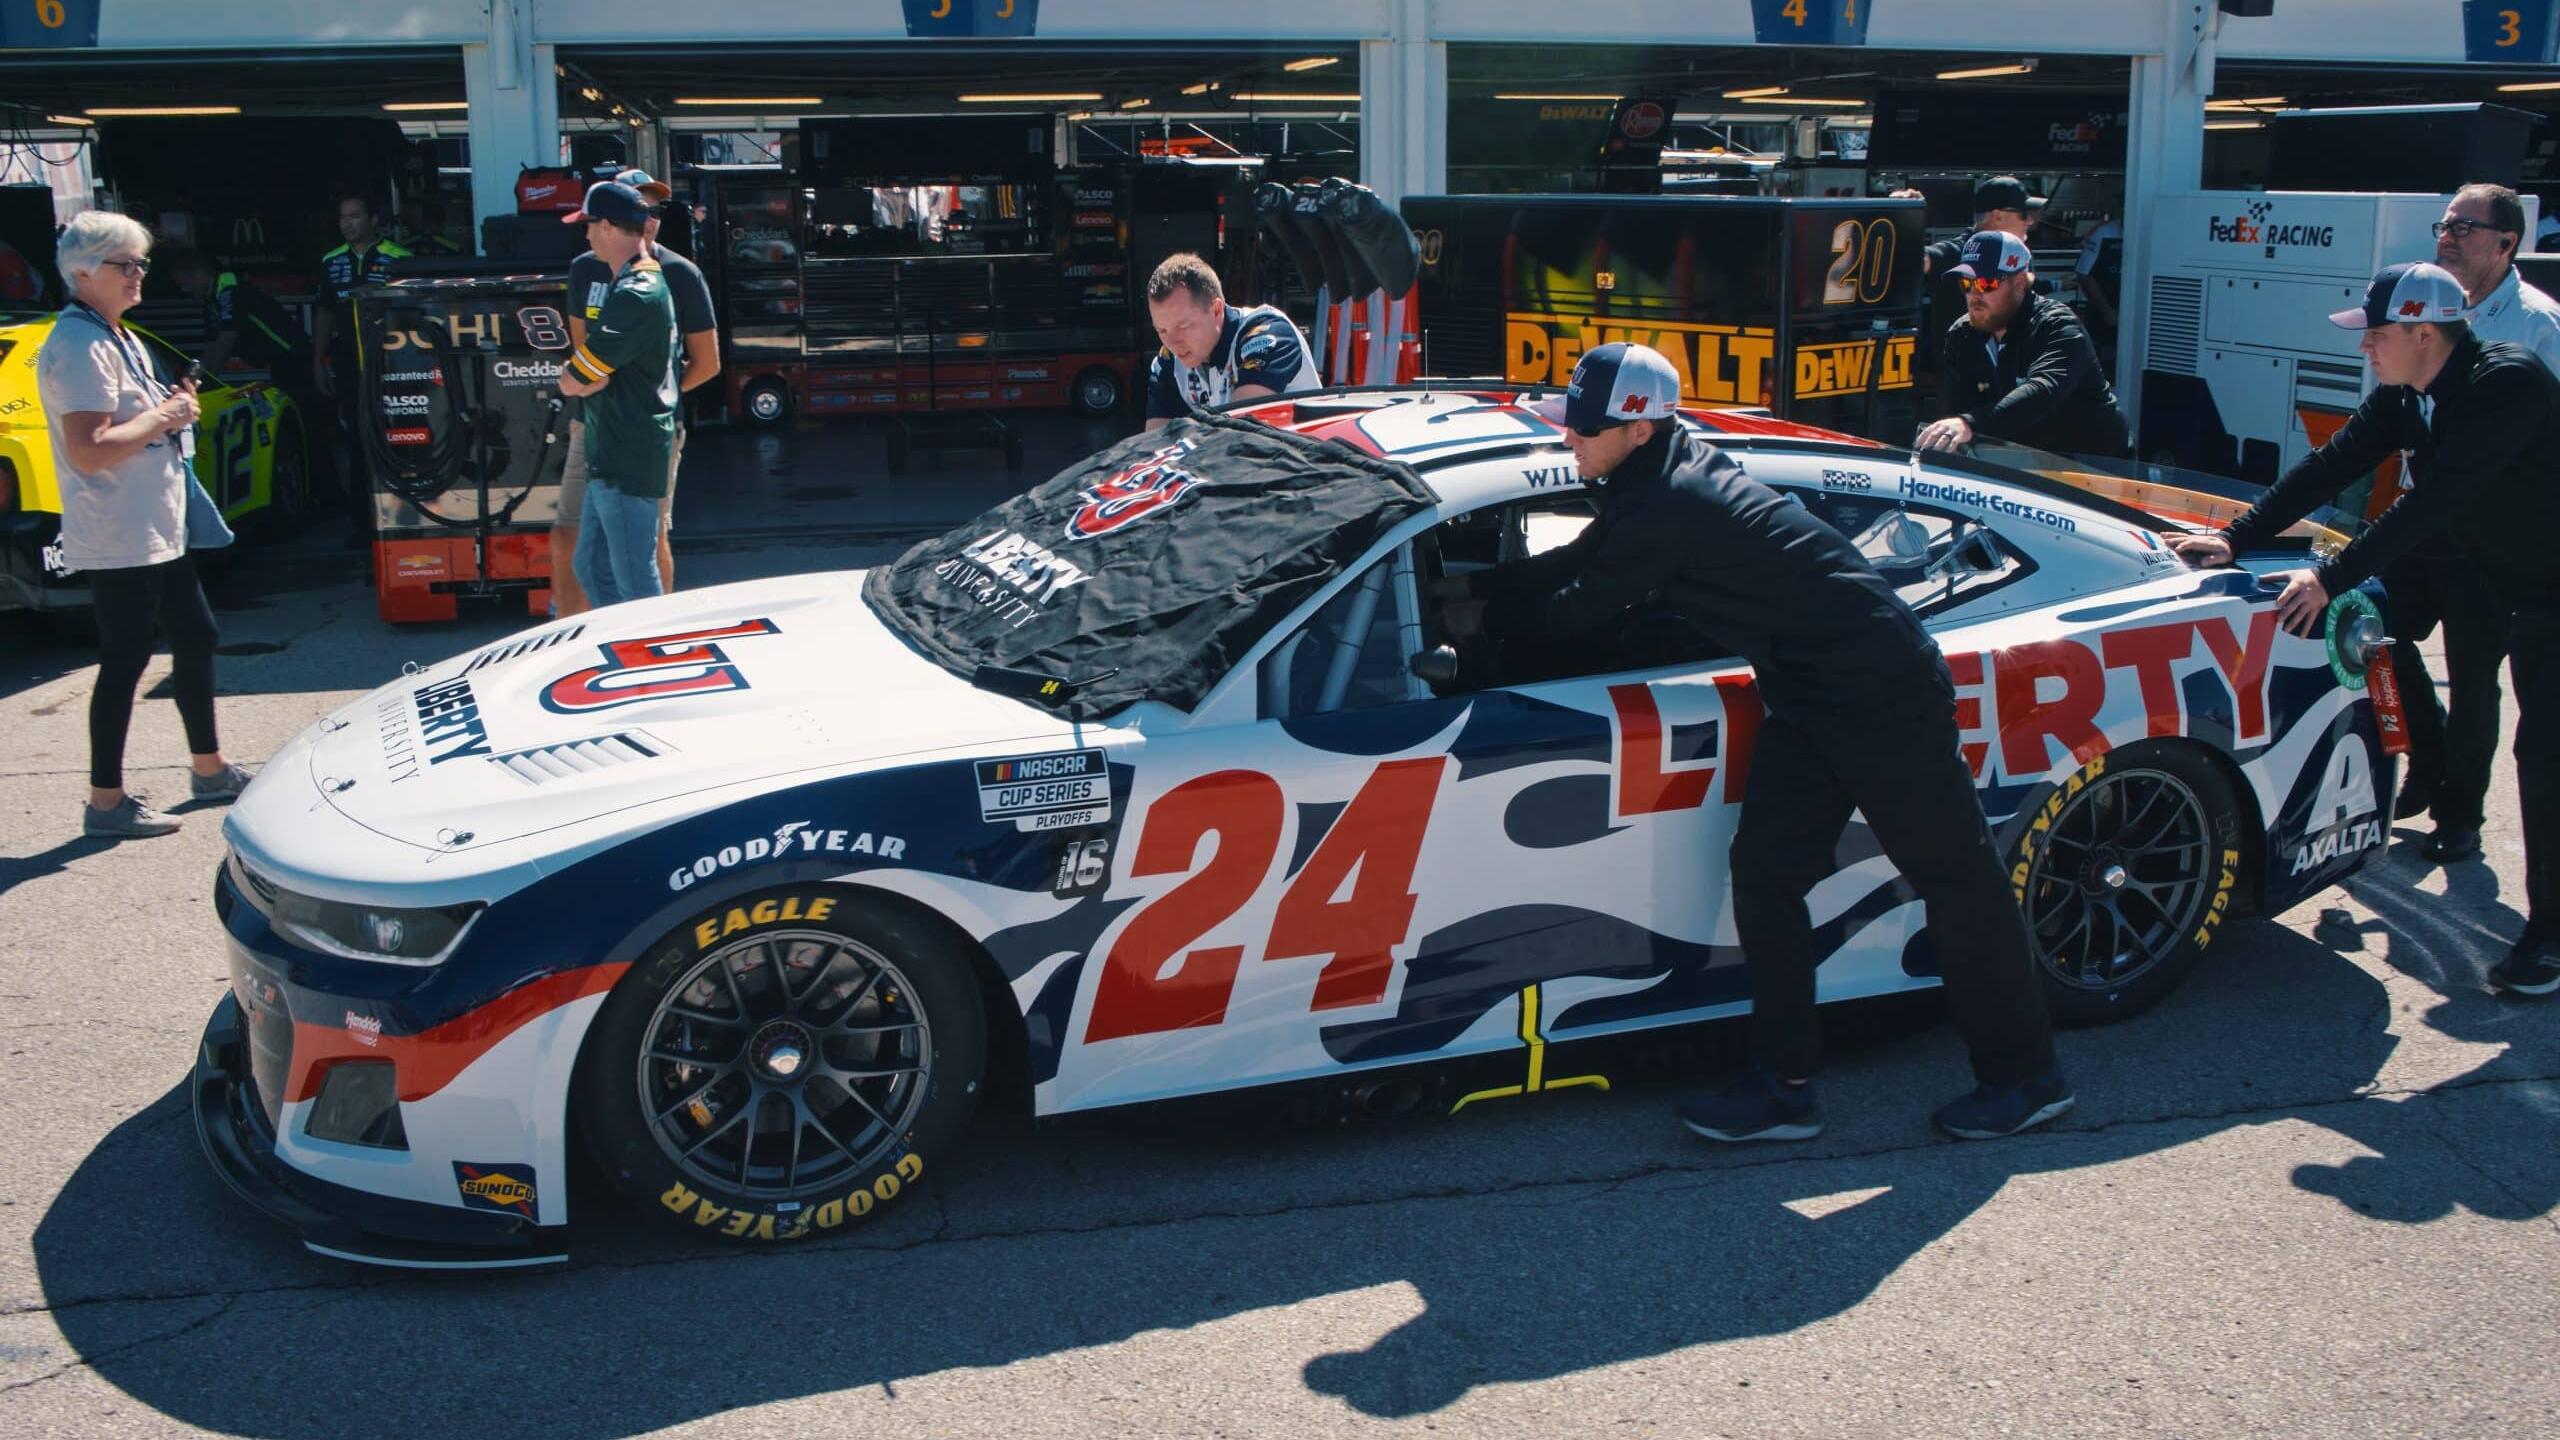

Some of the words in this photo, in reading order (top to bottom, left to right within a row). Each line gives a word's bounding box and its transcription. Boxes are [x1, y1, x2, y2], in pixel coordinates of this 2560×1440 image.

[34, 0, 65, 29] 6
[1782, 0, 1808, 27] 4
[2496, 9, 2520, 47] 3
[2209, 216, 2261, 243] FedEx
[2266, 224, 2335, 247] RACING
[1822, 217, 1897, 305] 20
[516, 306, 570, 350] 8
[494, 360, 568, 379] Cheddar
[386, 432, 427, 442] Lenovo
[1040, 680, 1060, 696] 24
[1607, 610, 2279, 818] LIERTY
[2380, 713, 2402, 733] 24
[1018, 755, 1087, 779] NASCAR
[999, 787, 1033, 808] CUP
[1035, 781, 1093, 804] SERIES
[1036, 811, 1093, 829] PLAYOFFS
[2289, 819, 2382, 877] AXALTA
[1062, 838, 1109, 890] 16
[1083, 754, 1447, 1046] 24
[2194, 849, 2239, 951] EAGLE
[694, 896, 838, 951] EAGLE
[346, 1011, 383, 1036] Hendrick
[465, 1181, 535, 1202] SUNOCO
